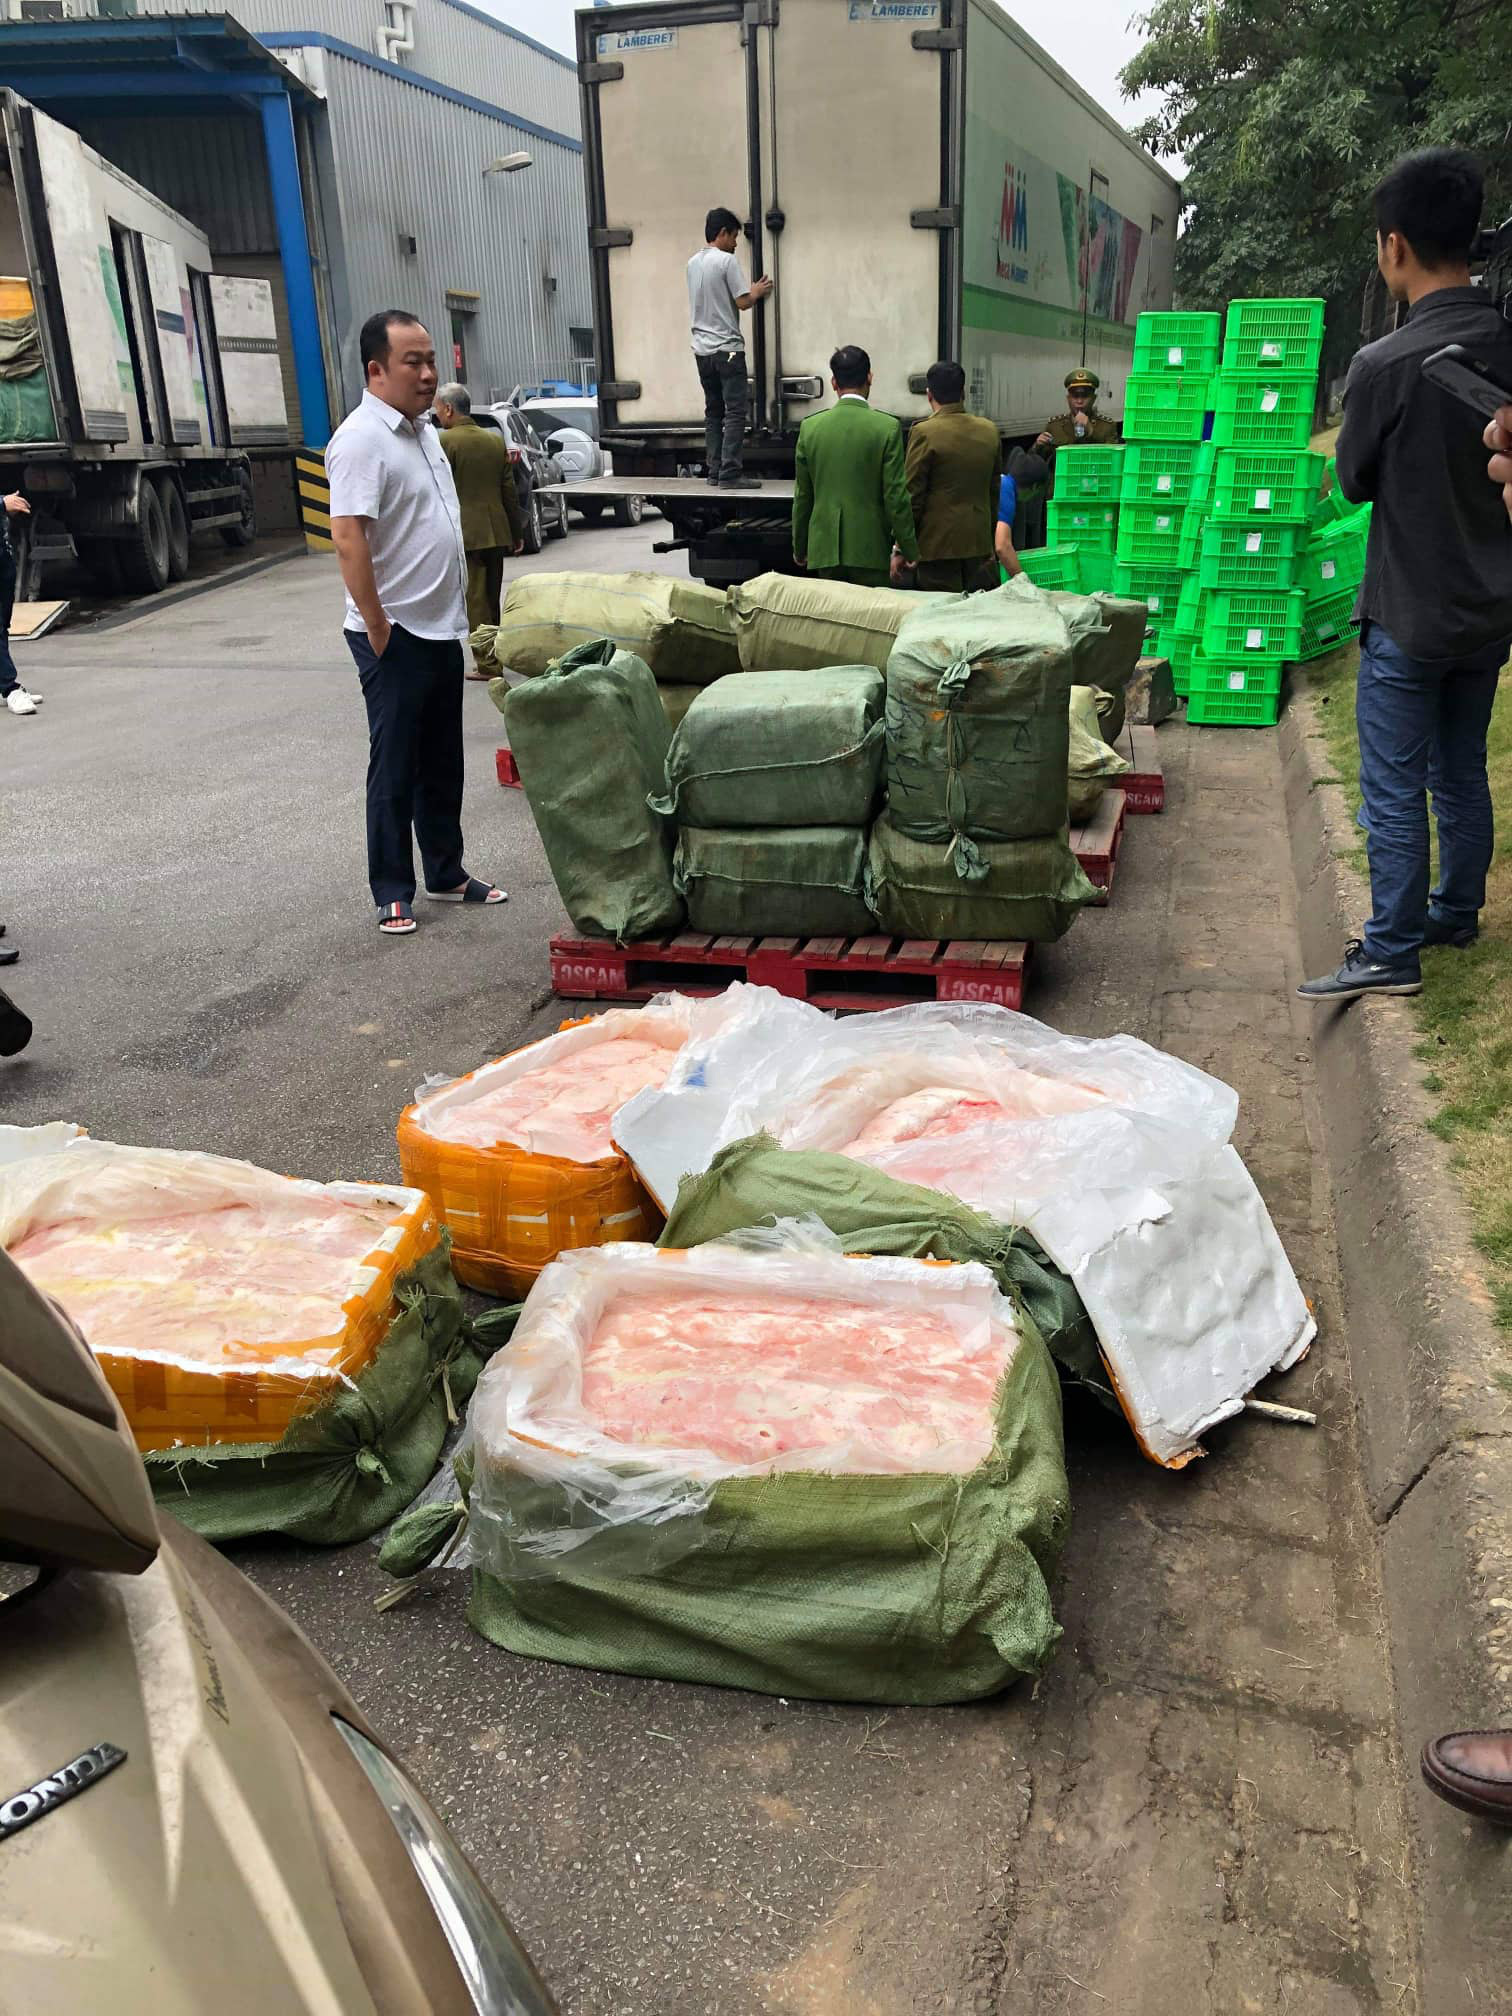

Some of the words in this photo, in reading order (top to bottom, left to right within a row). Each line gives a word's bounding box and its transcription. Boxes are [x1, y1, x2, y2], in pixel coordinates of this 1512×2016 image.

[871, 4, 938, 16] LAMBERET
[617, 32, 675, 48] LAMBERET
[1127, 792, 1163, 805] SCAM
[940, 976, 1021, 1008] LOSCAM
[0, 1743, 122, 1833] ONDA
